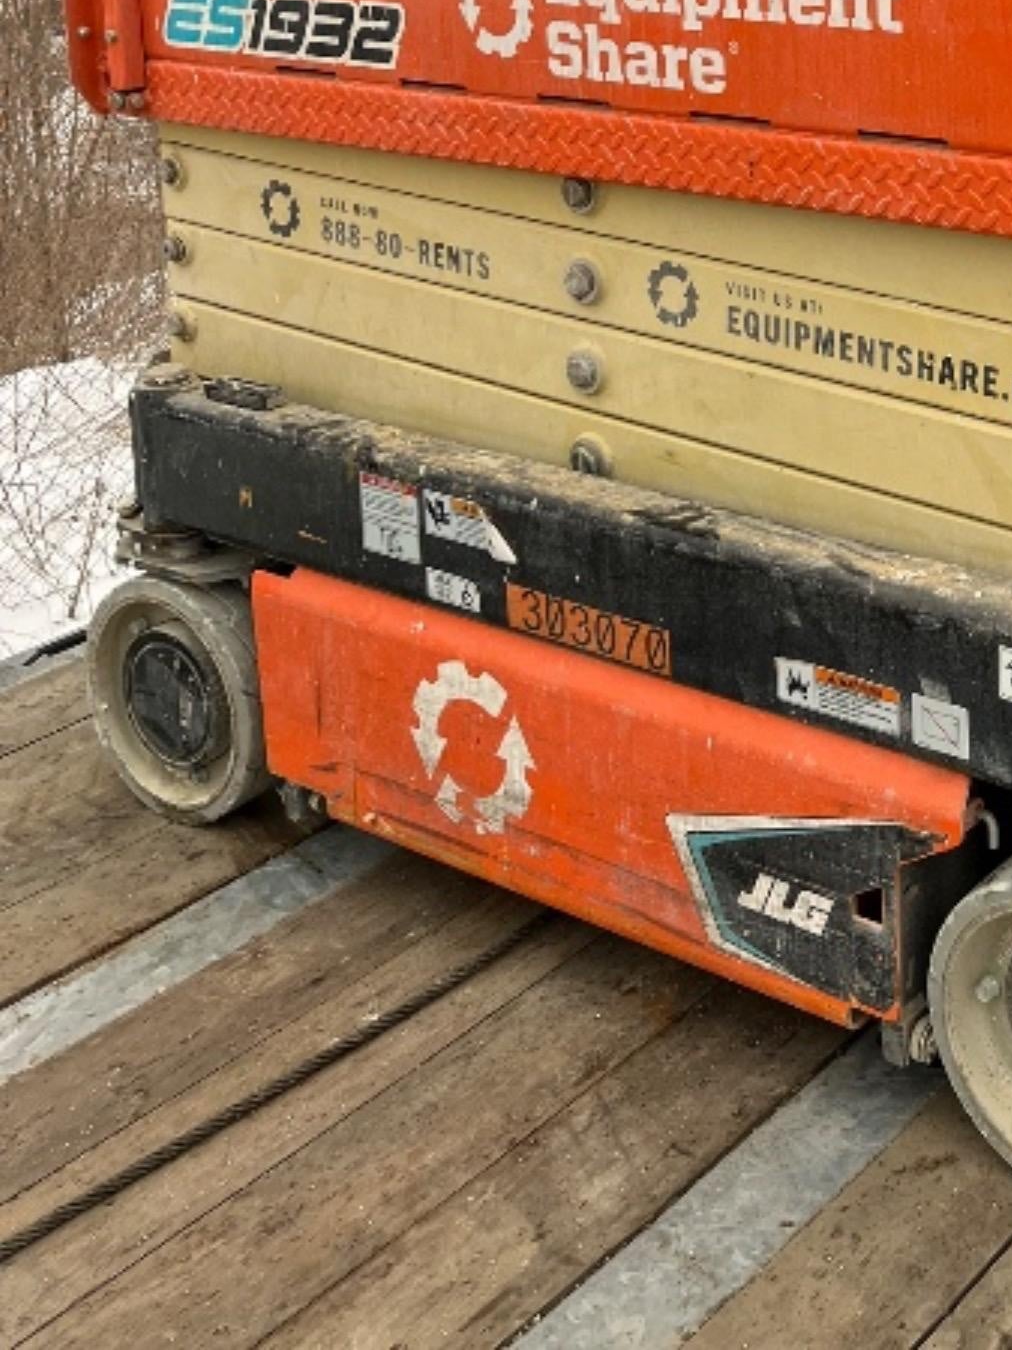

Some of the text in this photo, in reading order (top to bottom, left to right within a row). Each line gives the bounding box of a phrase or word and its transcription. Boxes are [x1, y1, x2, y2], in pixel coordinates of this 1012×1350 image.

[320, 215, 491, 280] 888-80-RENTS
[520, 588, 670, 671] 303070
[737, 872, 835, 937] JLG
